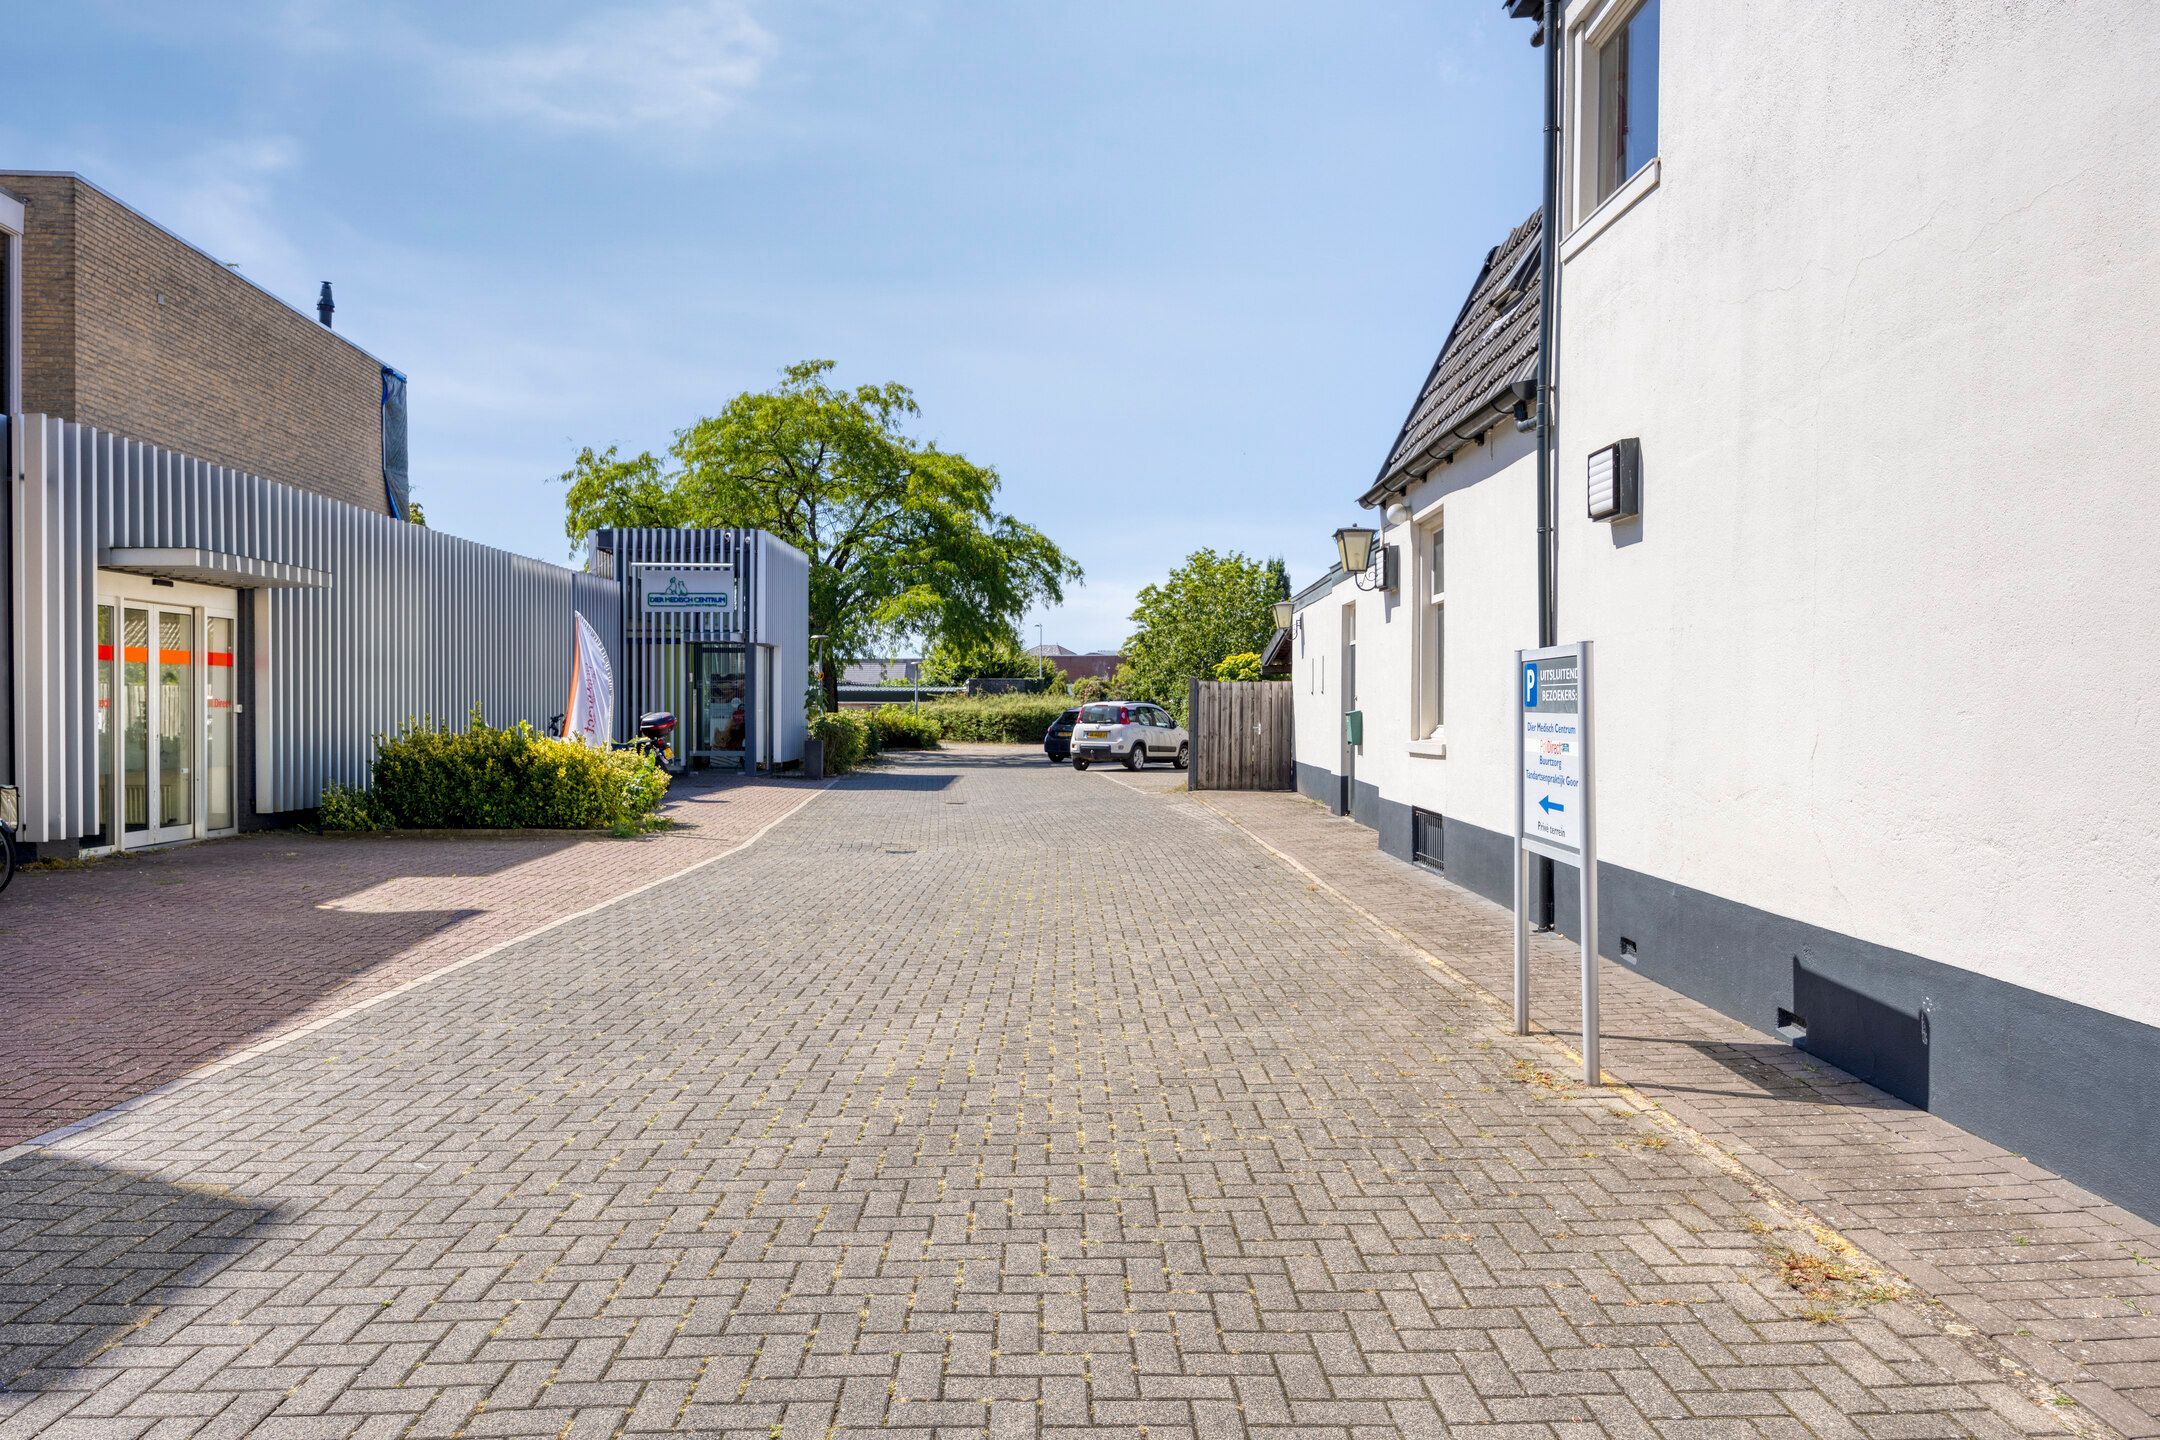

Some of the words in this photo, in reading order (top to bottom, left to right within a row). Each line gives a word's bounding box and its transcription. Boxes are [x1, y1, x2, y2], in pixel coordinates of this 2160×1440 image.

[1540, 668, 1578, 680] UITSLUITEND
[1527, 669, 1535, 702] P
[1542, 689, 1578, 702] BEZOEKERS:
[1527, 722, 1536, 731] Dier
[1537, 722, 1554, 733] Medisch
[1555, 723, 1576, 734] Centrum
[1540, 755, 1561, 771] Buurtzorg
[1526, 769, 1565, 787] Tandartsenpraktijk
[1566, 776, 1579, 787] Goor
[1550, 826, 1566, 838] terrein
